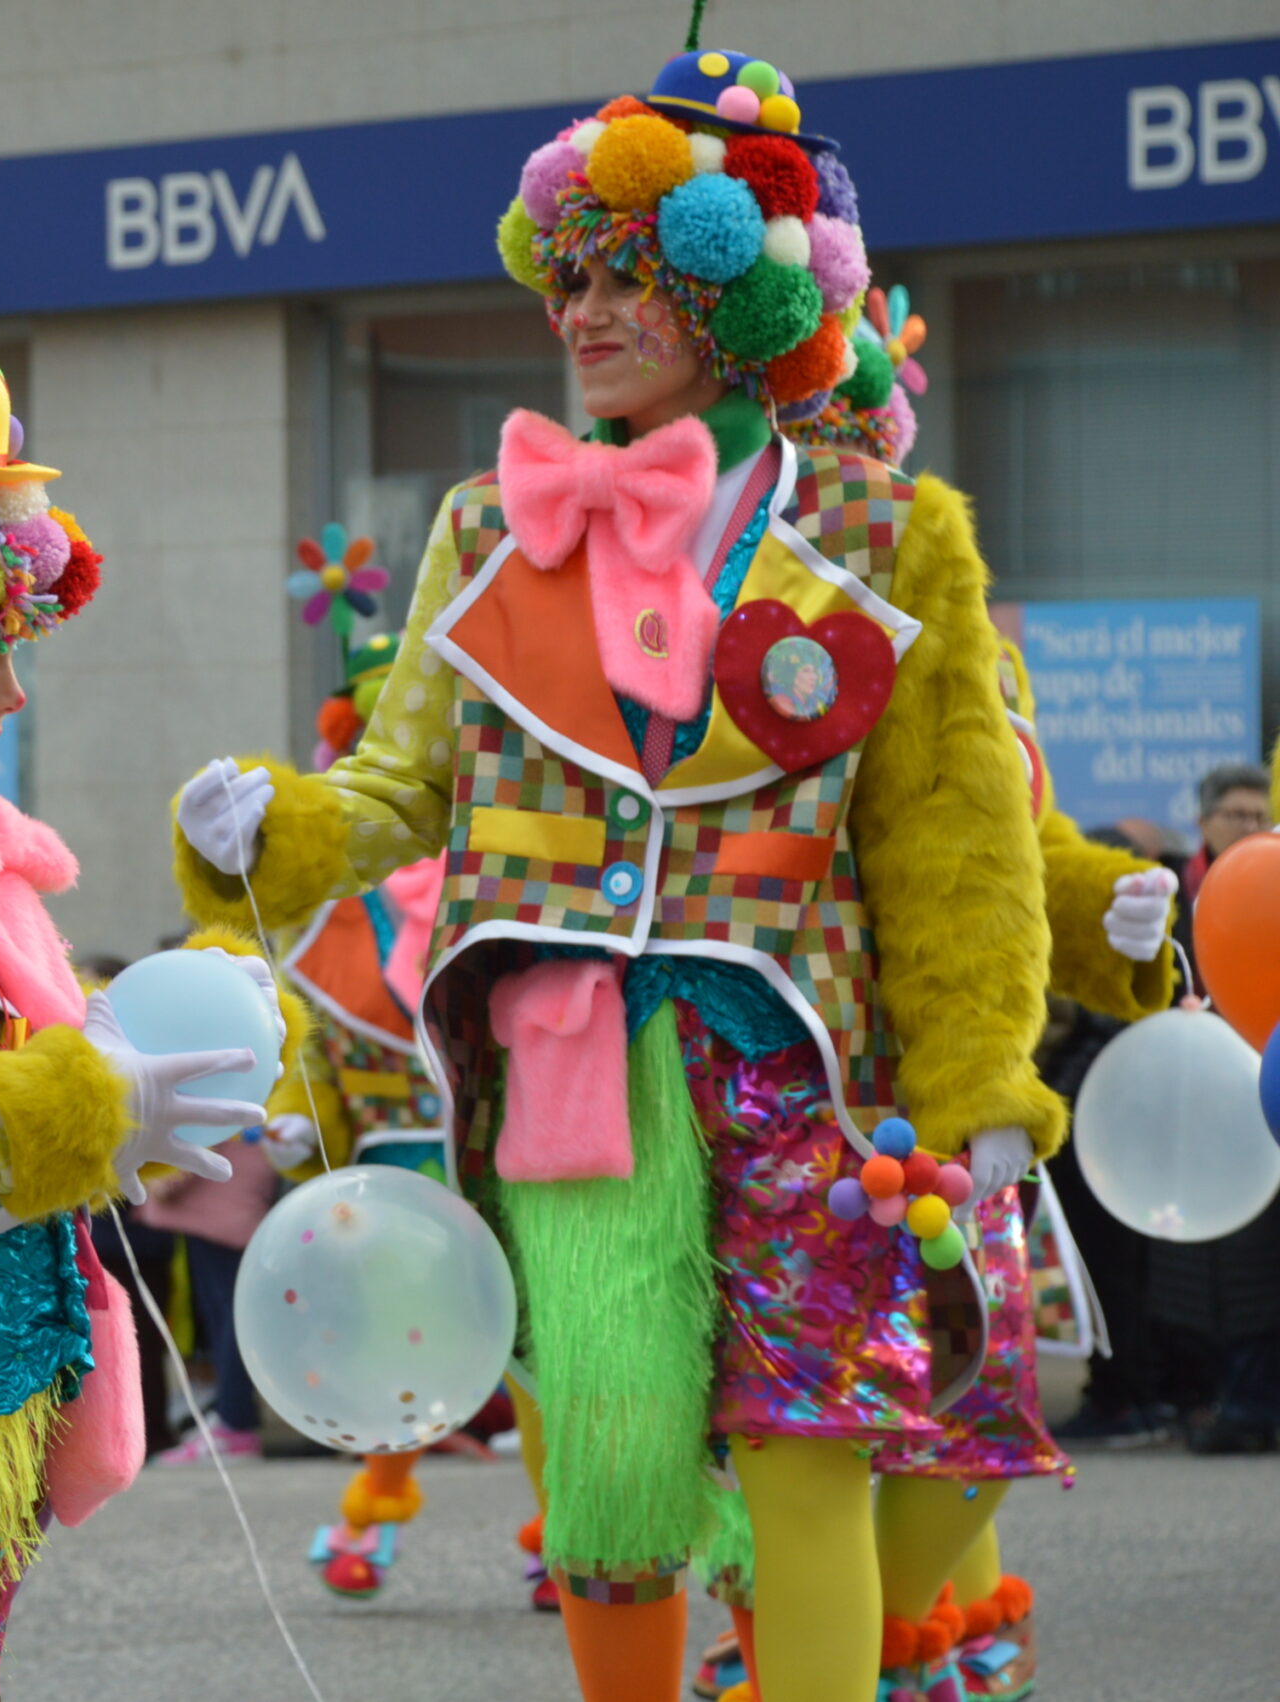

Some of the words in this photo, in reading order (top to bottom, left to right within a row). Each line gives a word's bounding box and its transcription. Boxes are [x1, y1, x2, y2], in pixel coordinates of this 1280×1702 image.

[1128, 75, 1280, 191] BB
[106, 152, 327, 271] BBVA
[1092, 743, 1144, 782] del
